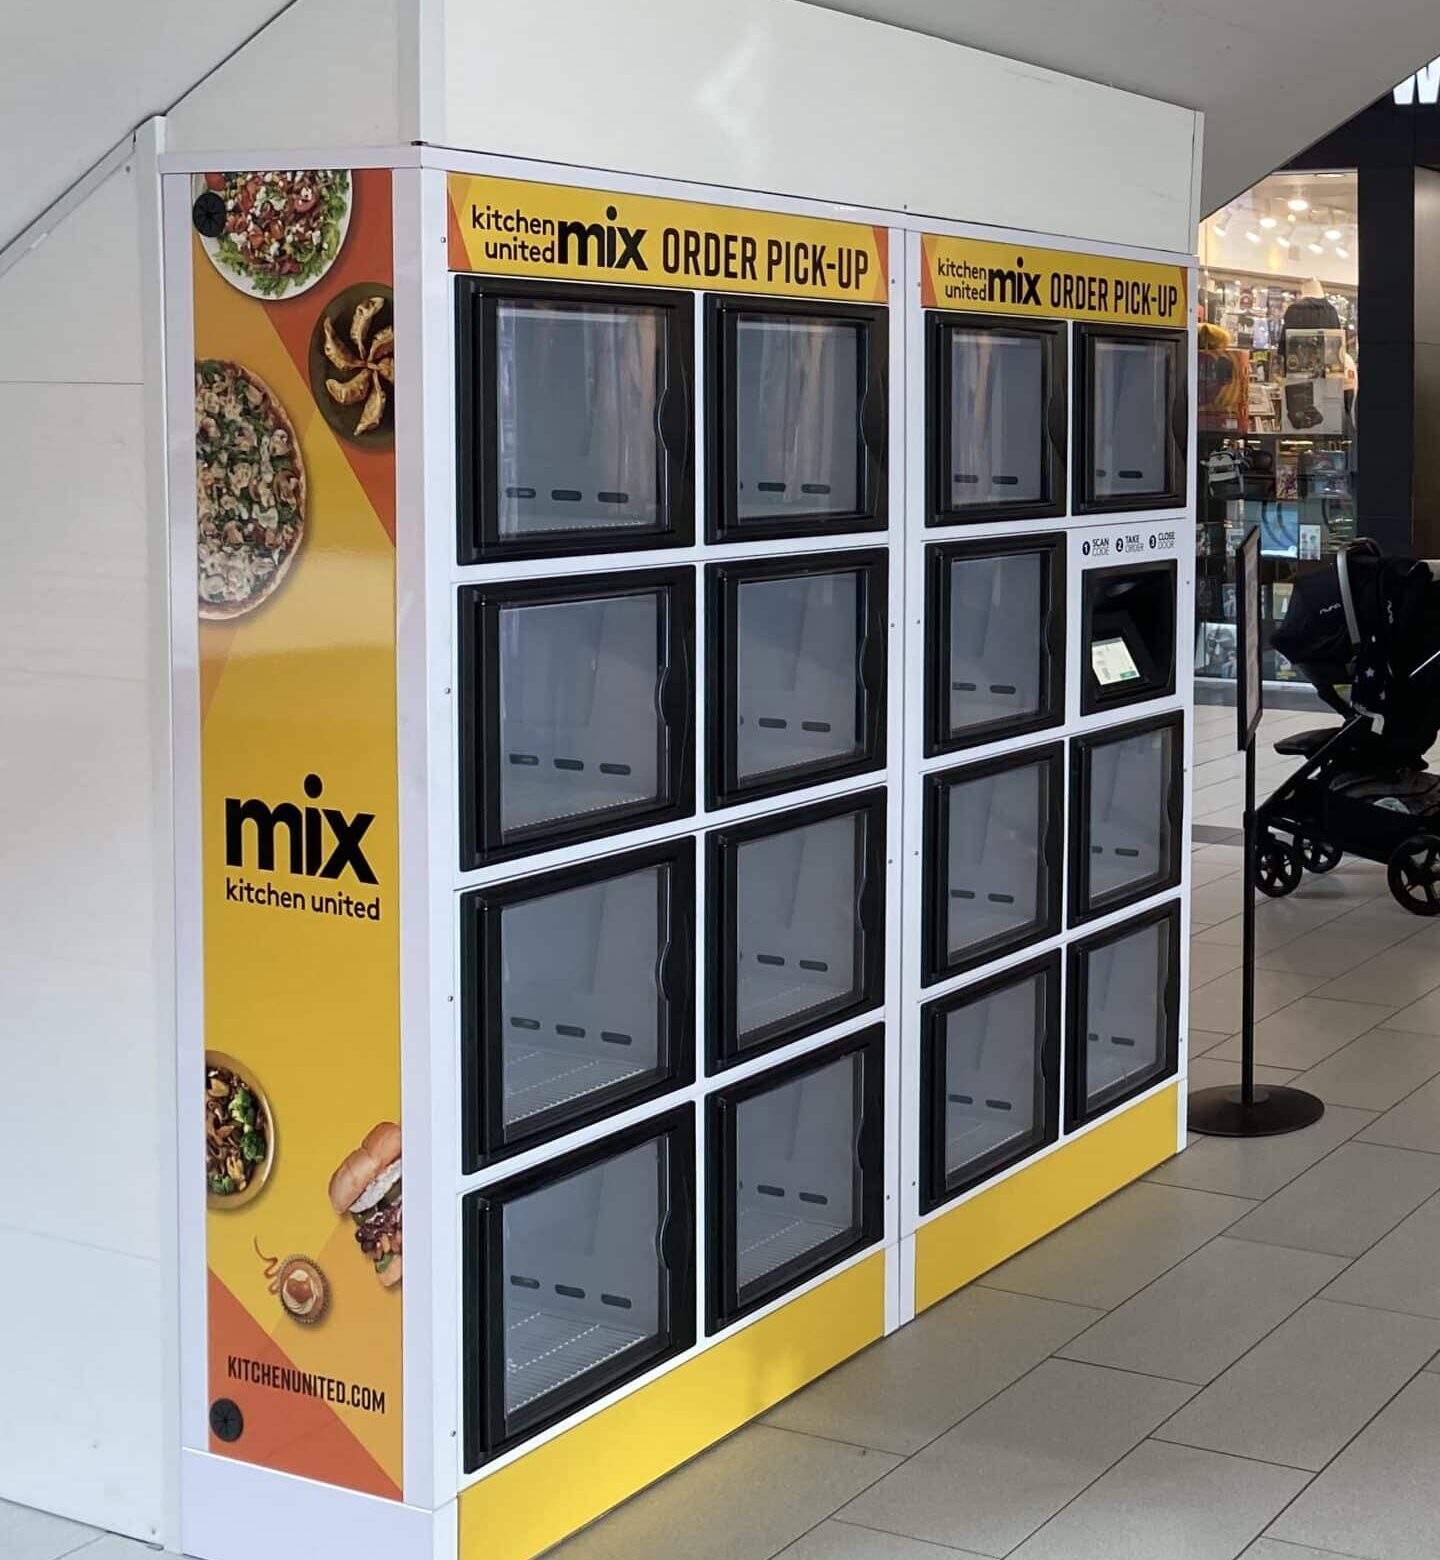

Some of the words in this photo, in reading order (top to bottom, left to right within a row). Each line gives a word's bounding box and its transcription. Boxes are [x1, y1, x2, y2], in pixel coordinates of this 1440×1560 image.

[471, 205, 556, 235] kitchen
[557, 205, 649, 270] mix
[485, 236, 556, 263] united
[662, 227, 756, 281] ORDER
[767, 238, 869, 290] PICK-UP
[937, 257, 987, 281] kitchen
[945, 280, 987, 301] united
[987, 256, 1042, 307] mix
[1050, 271, 1109, 311] ORDER
[1114, 278, 1179, 318] PICK-UP
[1092, 538, 1110, 547] SCAN
[1125, 535, 1140, 543] TAKE
[1158, 531, 1176, 541] CLOSE
[225, 773, 380, 885] mix
[226, 877, 306, 911] kitchen
[311, 891, 381, 921] united
[228, 1355, 386, 1414] KITCHENUNITED.COM
